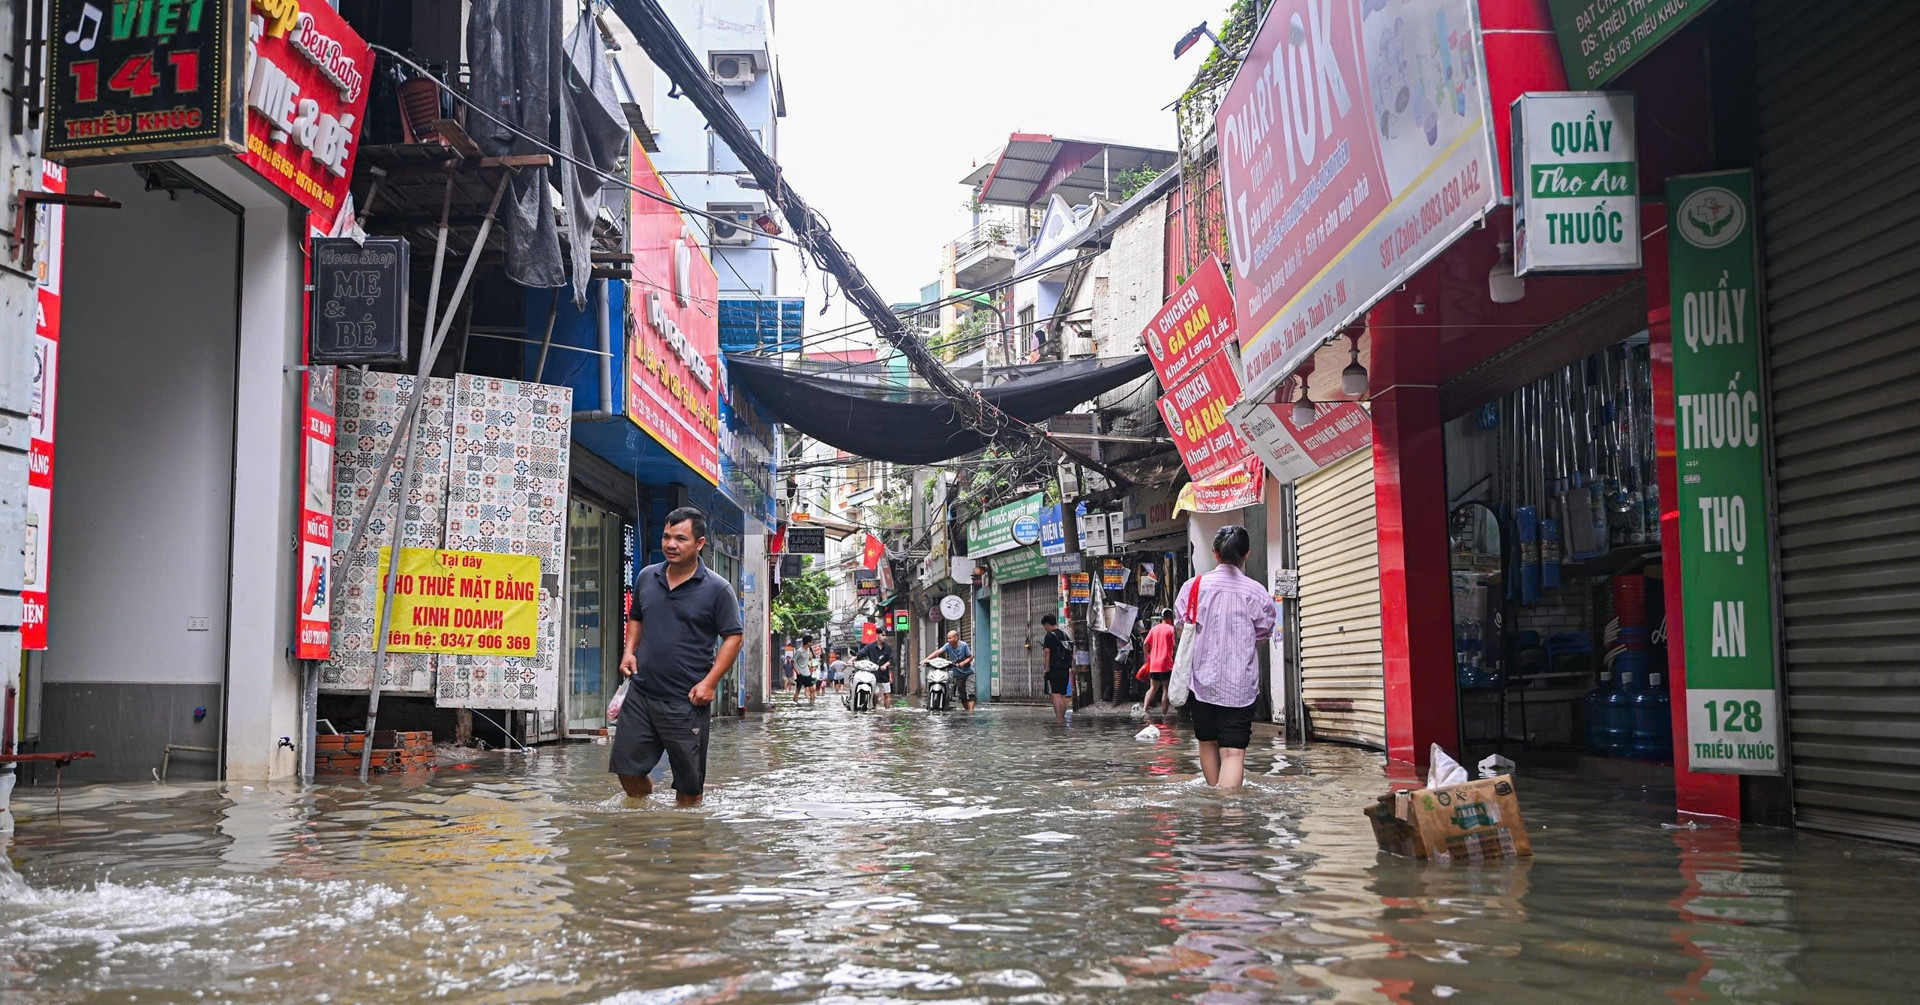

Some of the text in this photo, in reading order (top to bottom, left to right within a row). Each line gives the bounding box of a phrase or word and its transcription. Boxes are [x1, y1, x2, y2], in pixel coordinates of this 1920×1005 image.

[1576, 4, 1597, 32] ĐẠT
[1581, 34, 1599, 56] DS:
[1597, 7, 1627, 42] TRIỆU
[300, 15, 362, 102] Best Baby
[1603, 42, 1616, 67] SỐ
[1616, 36, 1631, 57] 128
[1631, 13, 1657, 44] TRIỀU
[69, 50, 200, 104] 141
[136, 104, 203, 131] KHÚC
[1550, 110, 1613, 157] QUẦY
[1420, 193, 1442, 235] 0983
[1442, 176, 1460, 216] 030
[1461, 159, 1480, 200] 442
[1537, 166, 1628, 196] Thọ An
[1325, 210, 1339, 236] cho
[1338, 188, 1354, 223] mọi
[1354, 172, 1370, 208] nhà
[1546, 200, 1623, 245] THUỐC
[360, 250, 396, 269] Shop
[333, 270, 381, 306] MẸ
[324, 300, 346, 318] &
[1158, 285, 1200, 334] CHICKEN
[1682, 270, 1747, 353] QUẦY
[335, 313, 378, 348] BÉ
[1164, 352, 1188, 380] Khoai
[1188, 334, 1212, 360] Lang
[1211, 315, 1230, 339] Lắc
[1168, 324, 1187, 355] GÀ
[1184, 304, 1210, 340] RÁN
[1175, 372, 1212, 411] CHICKEN
[1678, 372, 1759, 450] THUỐC
[1184, 408, 1206, 443] GÀ
[1185, 442, 1210, 466] Khoai
[1208, 430, 1234, 452] Lang
[1699, 494, 1747, 565] THỌ
[441, 553, 482, 570] Tại đây
[418, 573, 456, 597] THUÊ
[460, 575, 492, 603] MẶT
[495, 573, 534, 602] BẰNG
[412, 606, 504, 630] KINH DOANH
[1712, 601, 1746, 658] AN
[388, 631, 530, 650] iên hệ: 0347 906 369
[1703, 700, 1762, 732] 128
[1694, 739, 1775, 760] TRIỀU KHÚC
